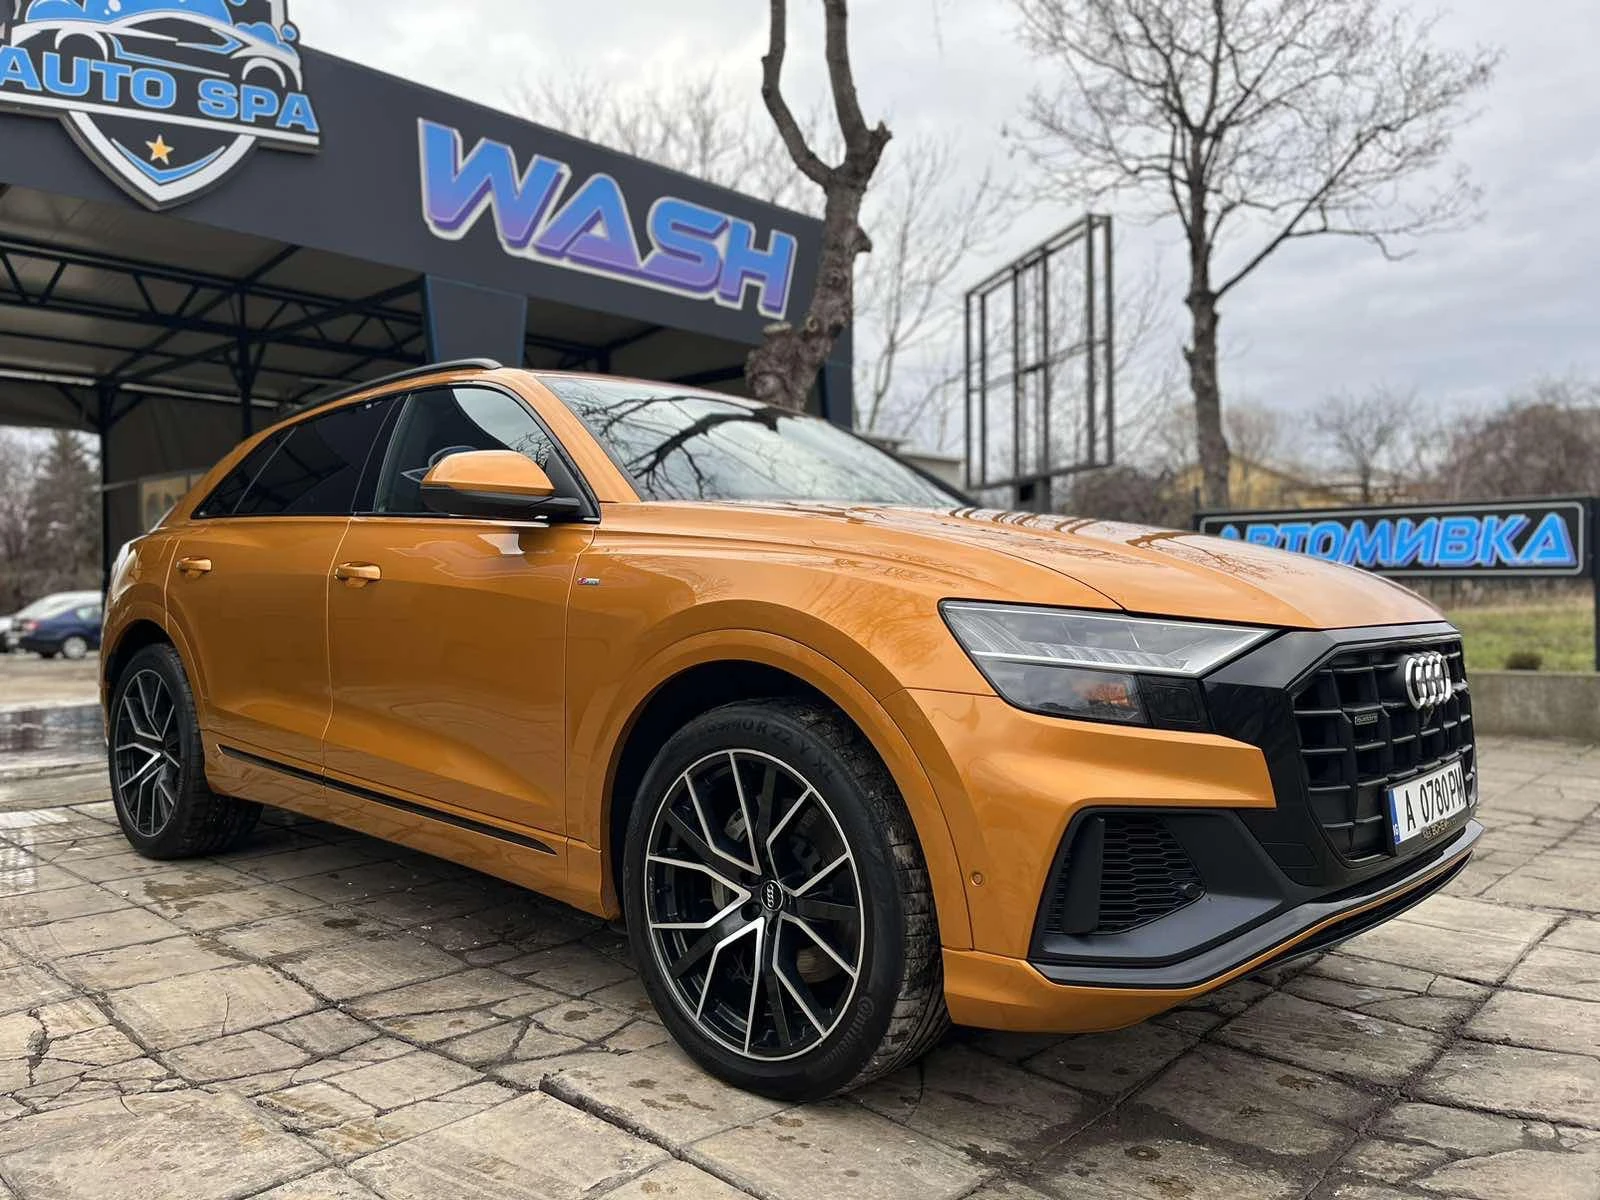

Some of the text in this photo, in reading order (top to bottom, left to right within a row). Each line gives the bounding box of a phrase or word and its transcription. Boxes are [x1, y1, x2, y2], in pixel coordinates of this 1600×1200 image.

[0, 45, 319, 133] AUTO SPA
[417, 117, 798, 320] WASH
[1405, 789, 1417, 832] A
